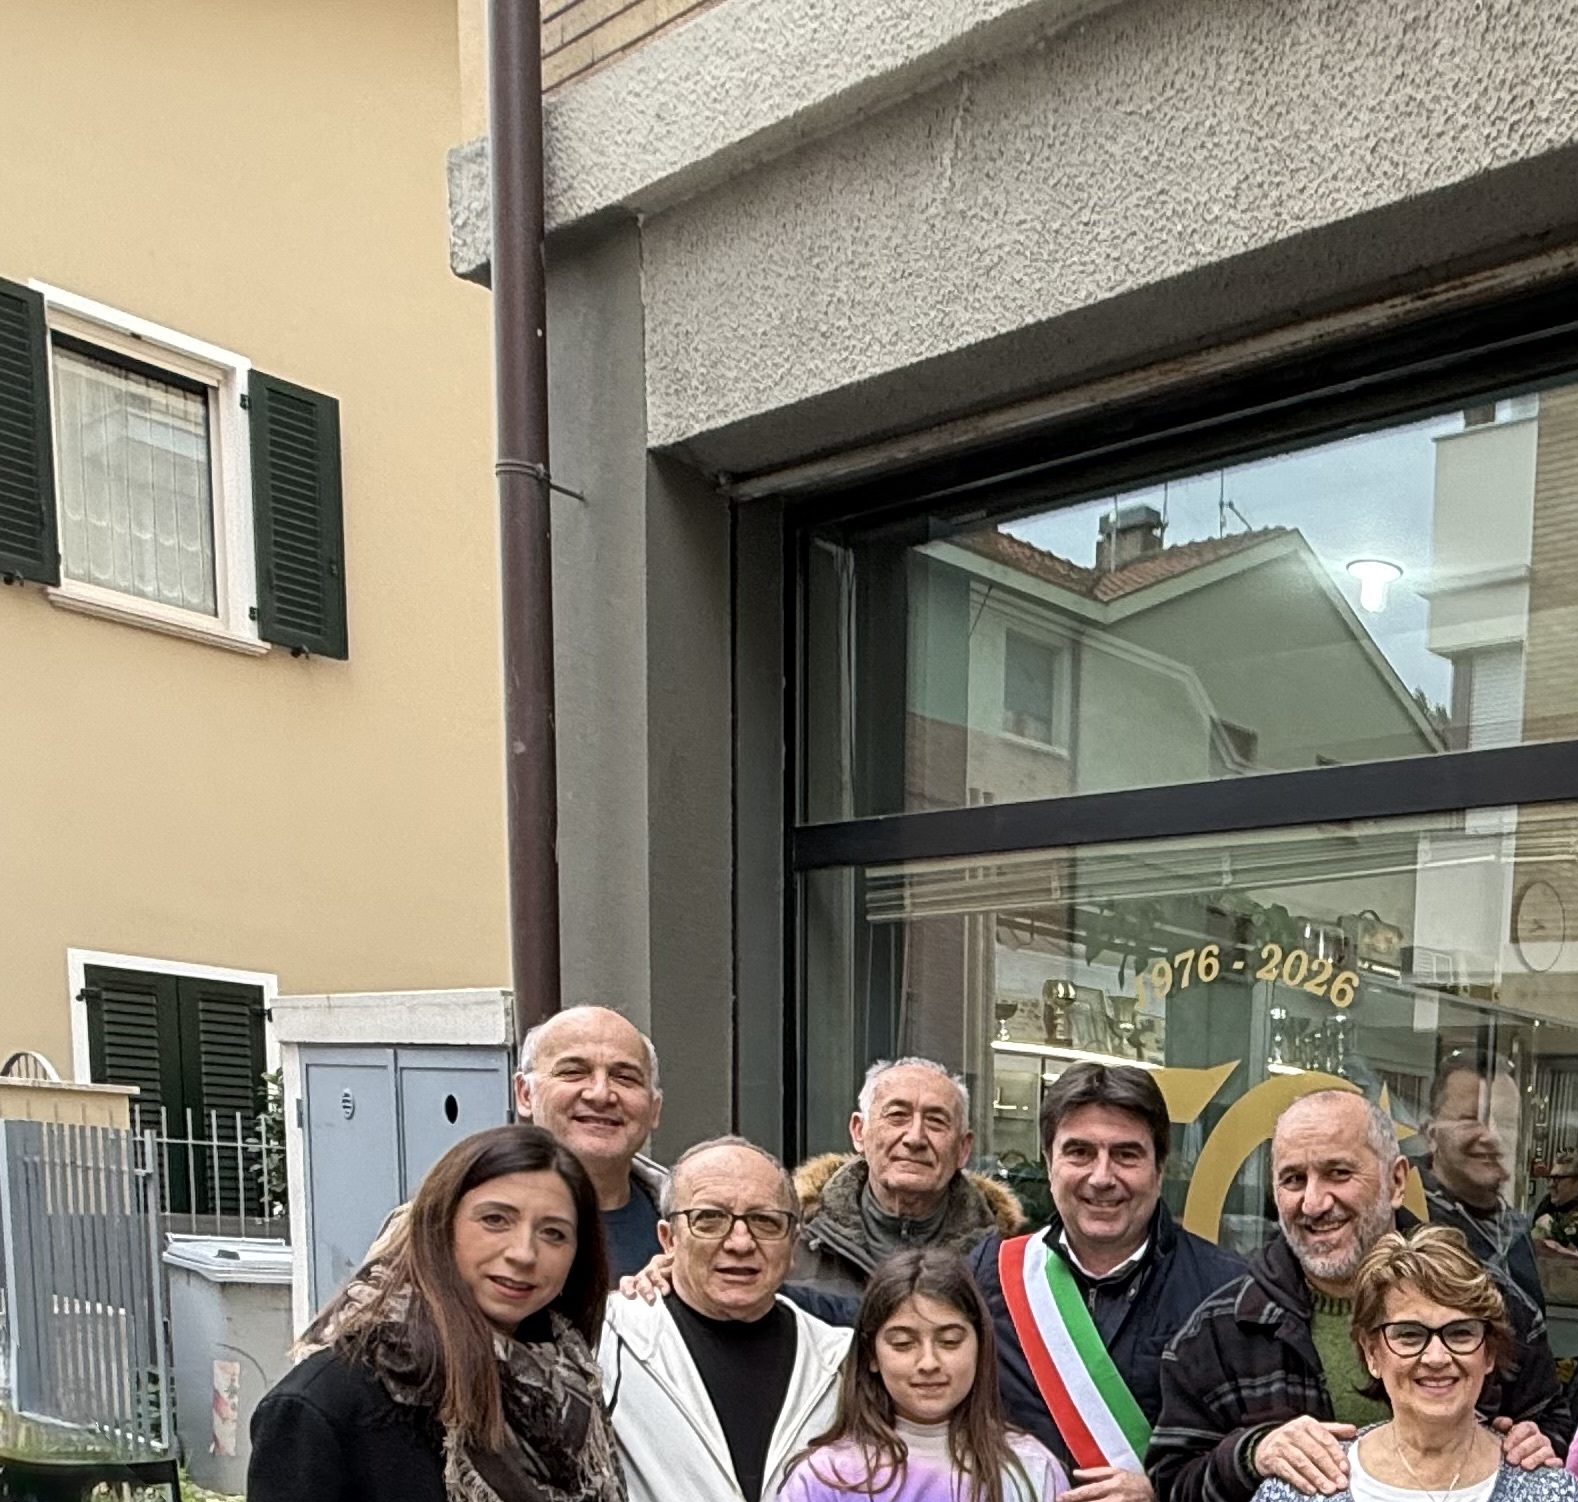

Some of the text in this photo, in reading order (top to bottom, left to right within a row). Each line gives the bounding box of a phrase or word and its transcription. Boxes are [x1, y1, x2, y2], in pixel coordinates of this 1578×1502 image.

[1134, 943, 1359, 1009] 1976 - 2026
